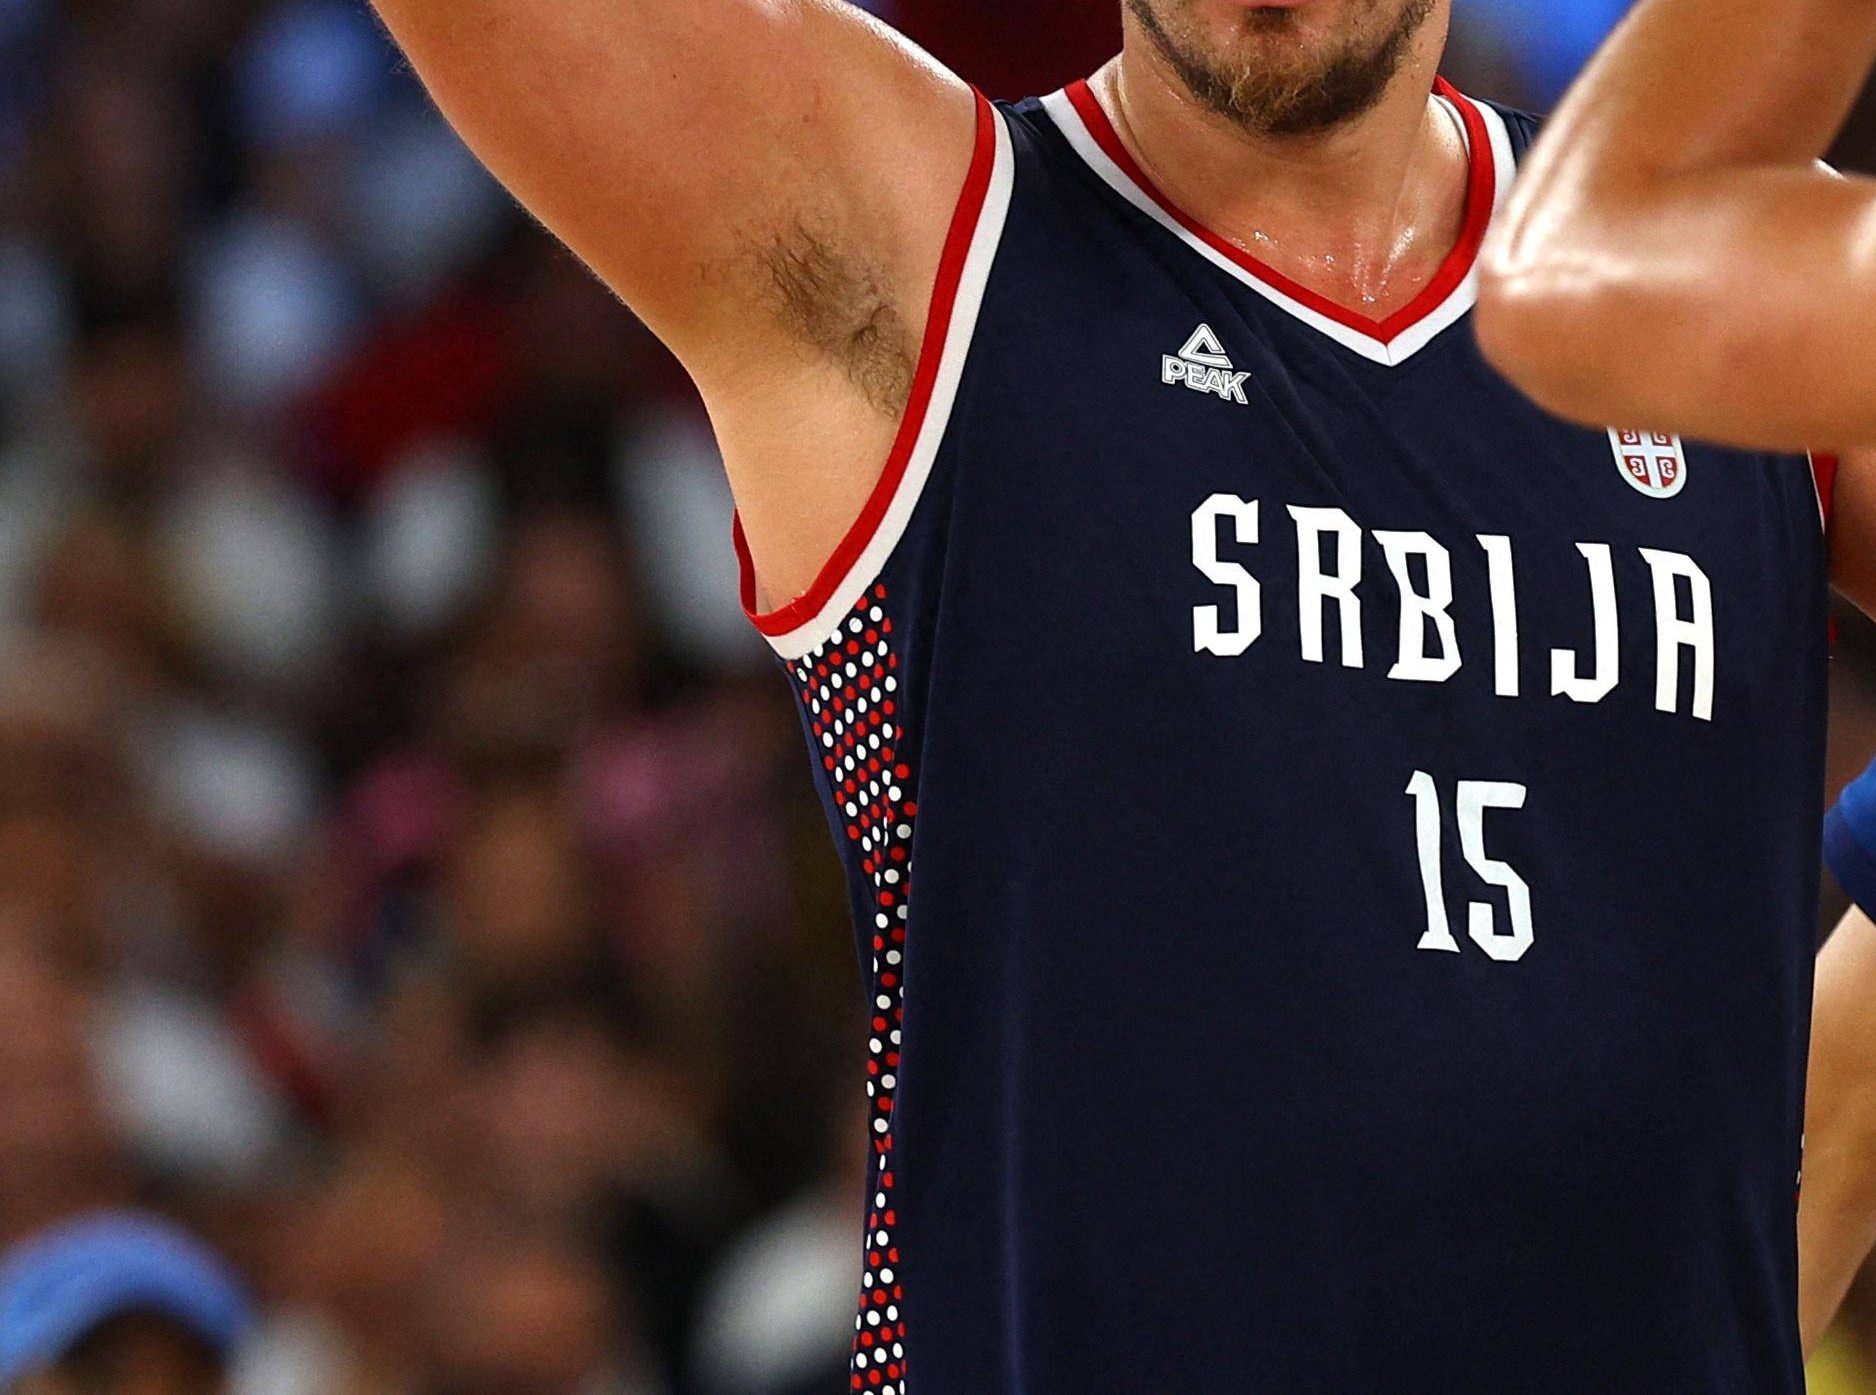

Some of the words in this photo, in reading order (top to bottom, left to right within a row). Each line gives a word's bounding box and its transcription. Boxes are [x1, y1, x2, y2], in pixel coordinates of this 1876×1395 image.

[1161, 353, 1252, 405] PEAK
[1191, 492, 1715, 721] SRBIJA
[1405, 769, 1535, 962] 15
